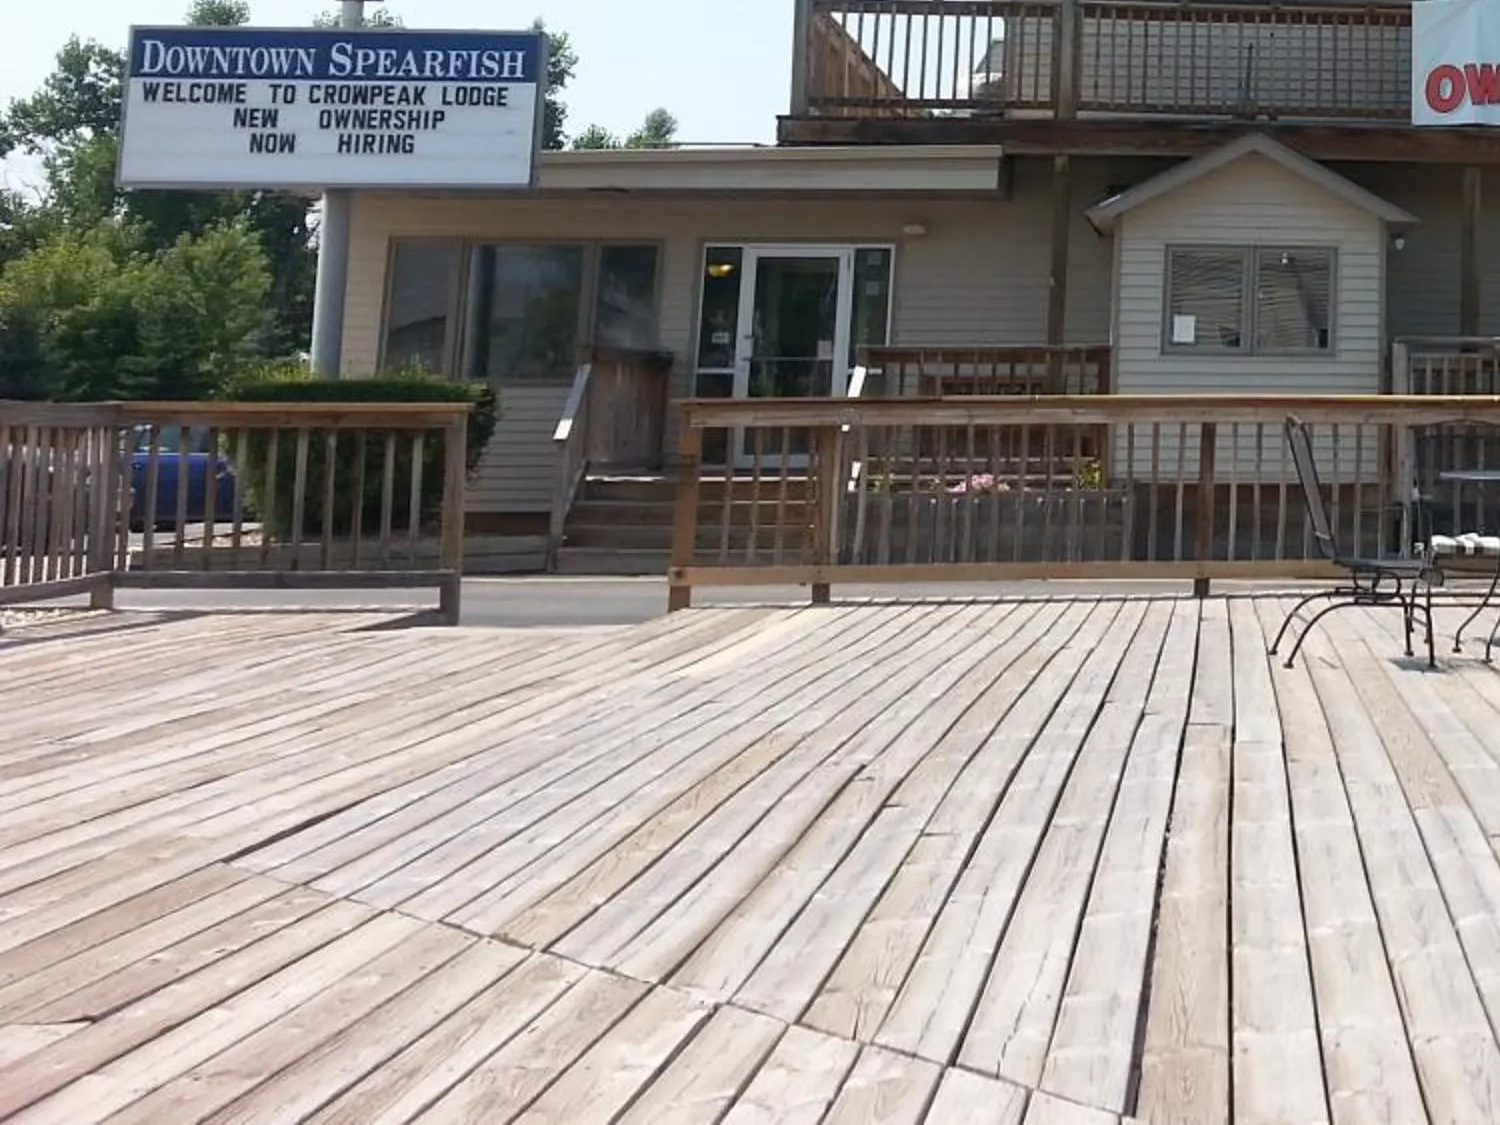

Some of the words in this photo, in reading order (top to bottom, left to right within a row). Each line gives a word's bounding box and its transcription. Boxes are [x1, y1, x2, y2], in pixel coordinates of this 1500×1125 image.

[140, 39, 316, 76] DOWNTOWN
[329, 42, 526, 79] SPEARFISH
[142, 83, 247, 104] WELCOME
[269, 84, 296, 104] TO
[308, 85, 427, 106] CROWPEAK
[441, 86, 509, 106] LODGE
[233, 108, 279, 128] NEW
[319, 109, 446, 131] OWNERSHIP
[249, 133, 296, 154] NOW
[338, 134, 415, 154] HIRING
